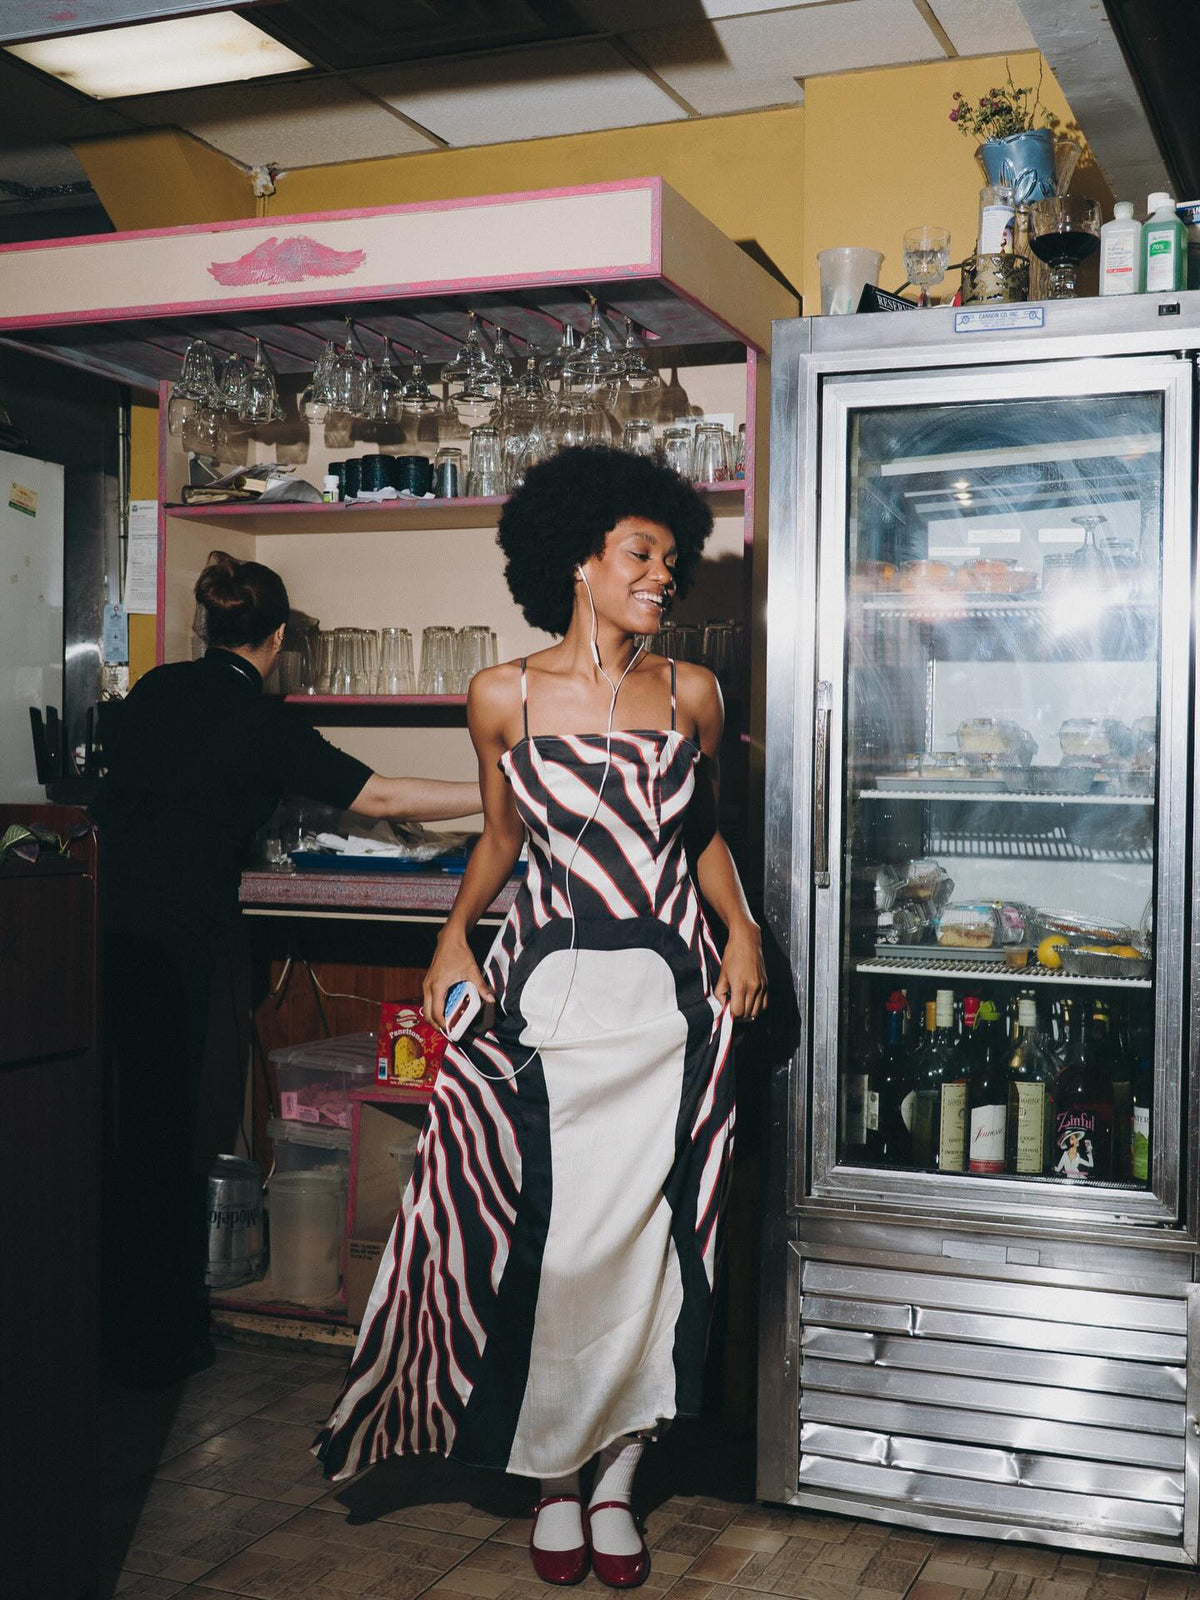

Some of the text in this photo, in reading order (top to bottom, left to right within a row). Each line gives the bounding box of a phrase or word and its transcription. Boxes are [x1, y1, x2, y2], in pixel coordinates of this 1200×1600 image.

[877, 294, 914, 312] RESERV
[388, 1028, 424, 1044] Panettone
[1057, 1111, 1095, 1132] Zinful
